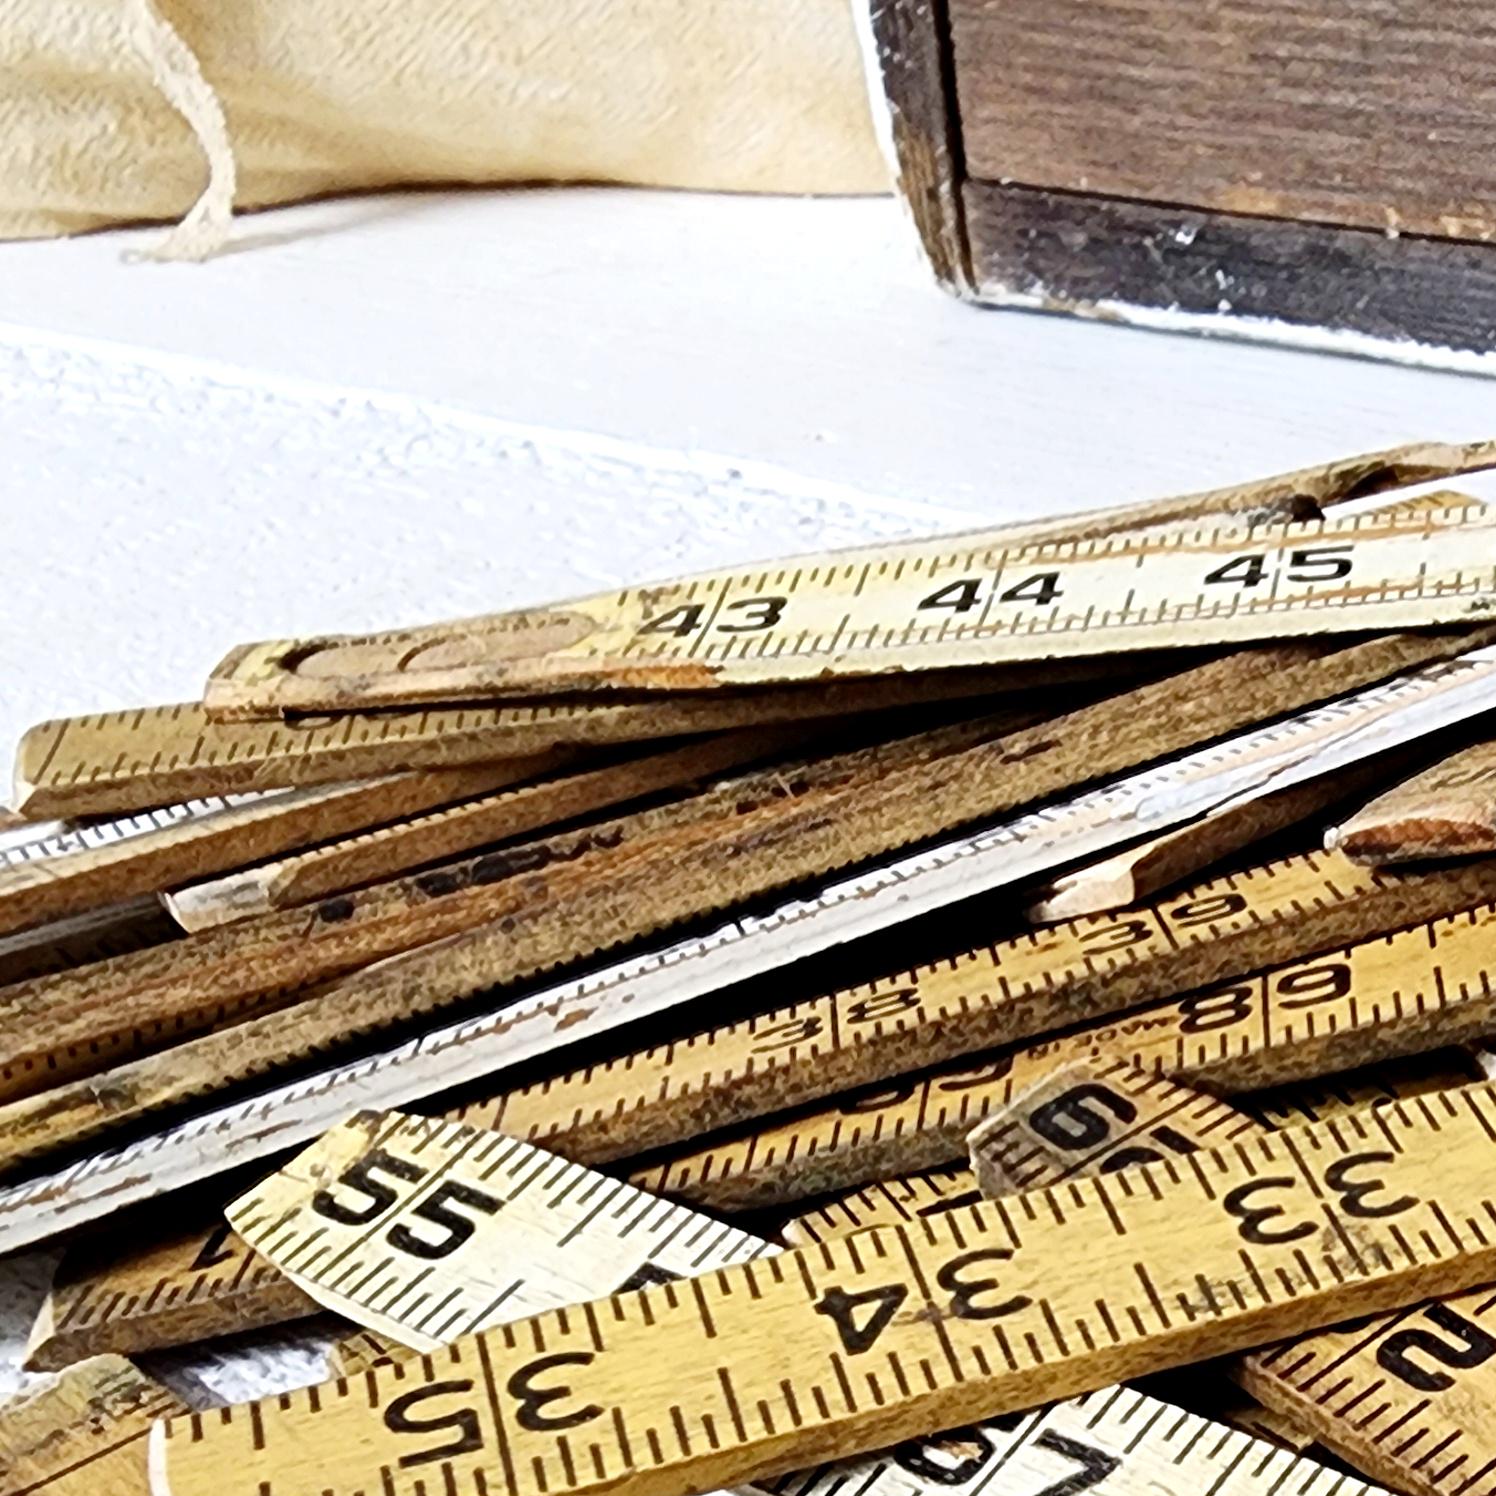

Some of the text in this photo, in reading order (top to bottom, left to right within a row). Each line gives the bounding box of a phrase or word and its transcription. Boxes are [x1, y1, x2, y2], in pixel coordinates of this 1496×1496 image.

[636, 596, 787, 640] 43
[917, 571, 1063, 614] 44
[1203, 545, 1355, 589] 45
[751, 988, 923, 1055] 38
[1077, 893, 1248, 956] 39
[312, 1149, 507, 1260] 55
[1223, 1151, 1420, 1245] 33
[814, 1248, 1034, 1356] 34
[384, 1352, 606, 1467] 35
